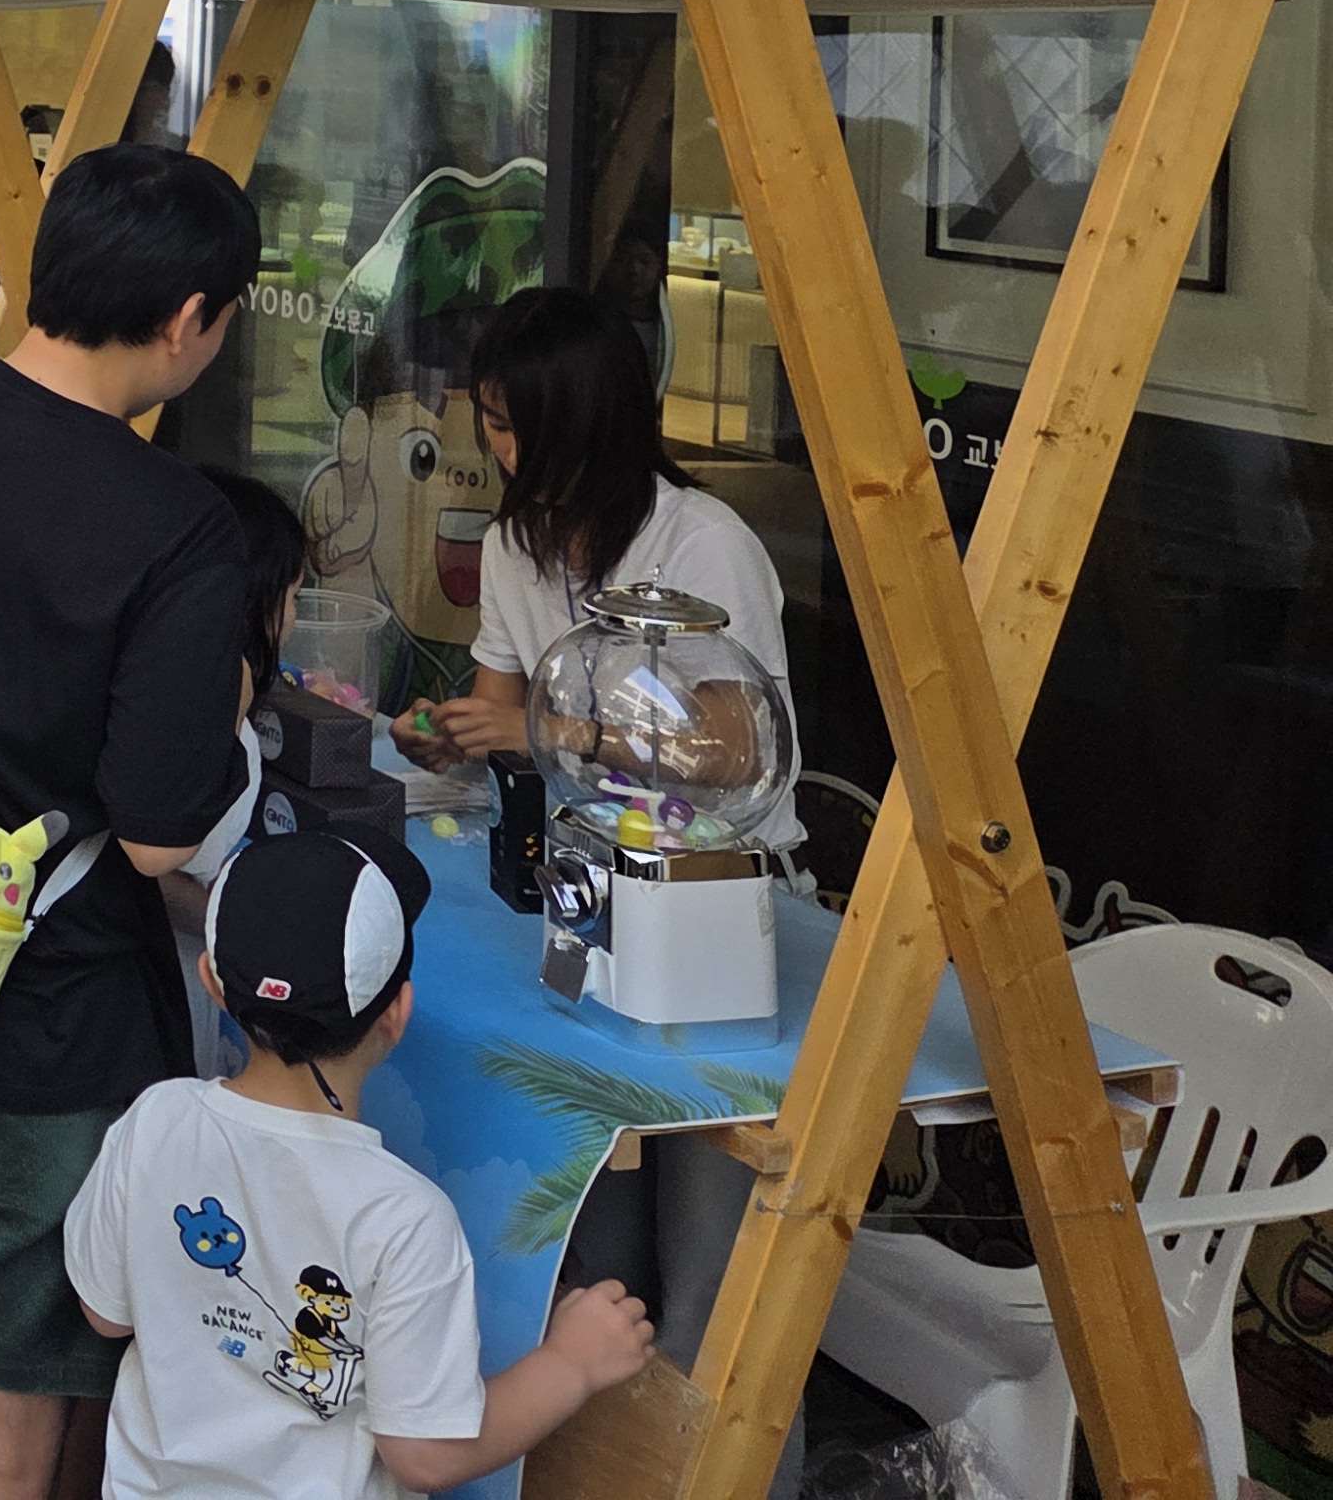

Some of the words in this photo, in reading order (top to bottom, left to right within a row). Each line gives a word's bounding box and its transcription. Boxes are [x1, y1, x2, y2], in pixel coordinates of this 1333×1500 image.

[238, 282, 315, 324] YOBO
[318, 303, 376, 336] 교보문고
[265, 807, 294, 831] GNTO
[202, 1313, 264, 1341] BALANCE
[216, 1305, 251, 1322] NEW
